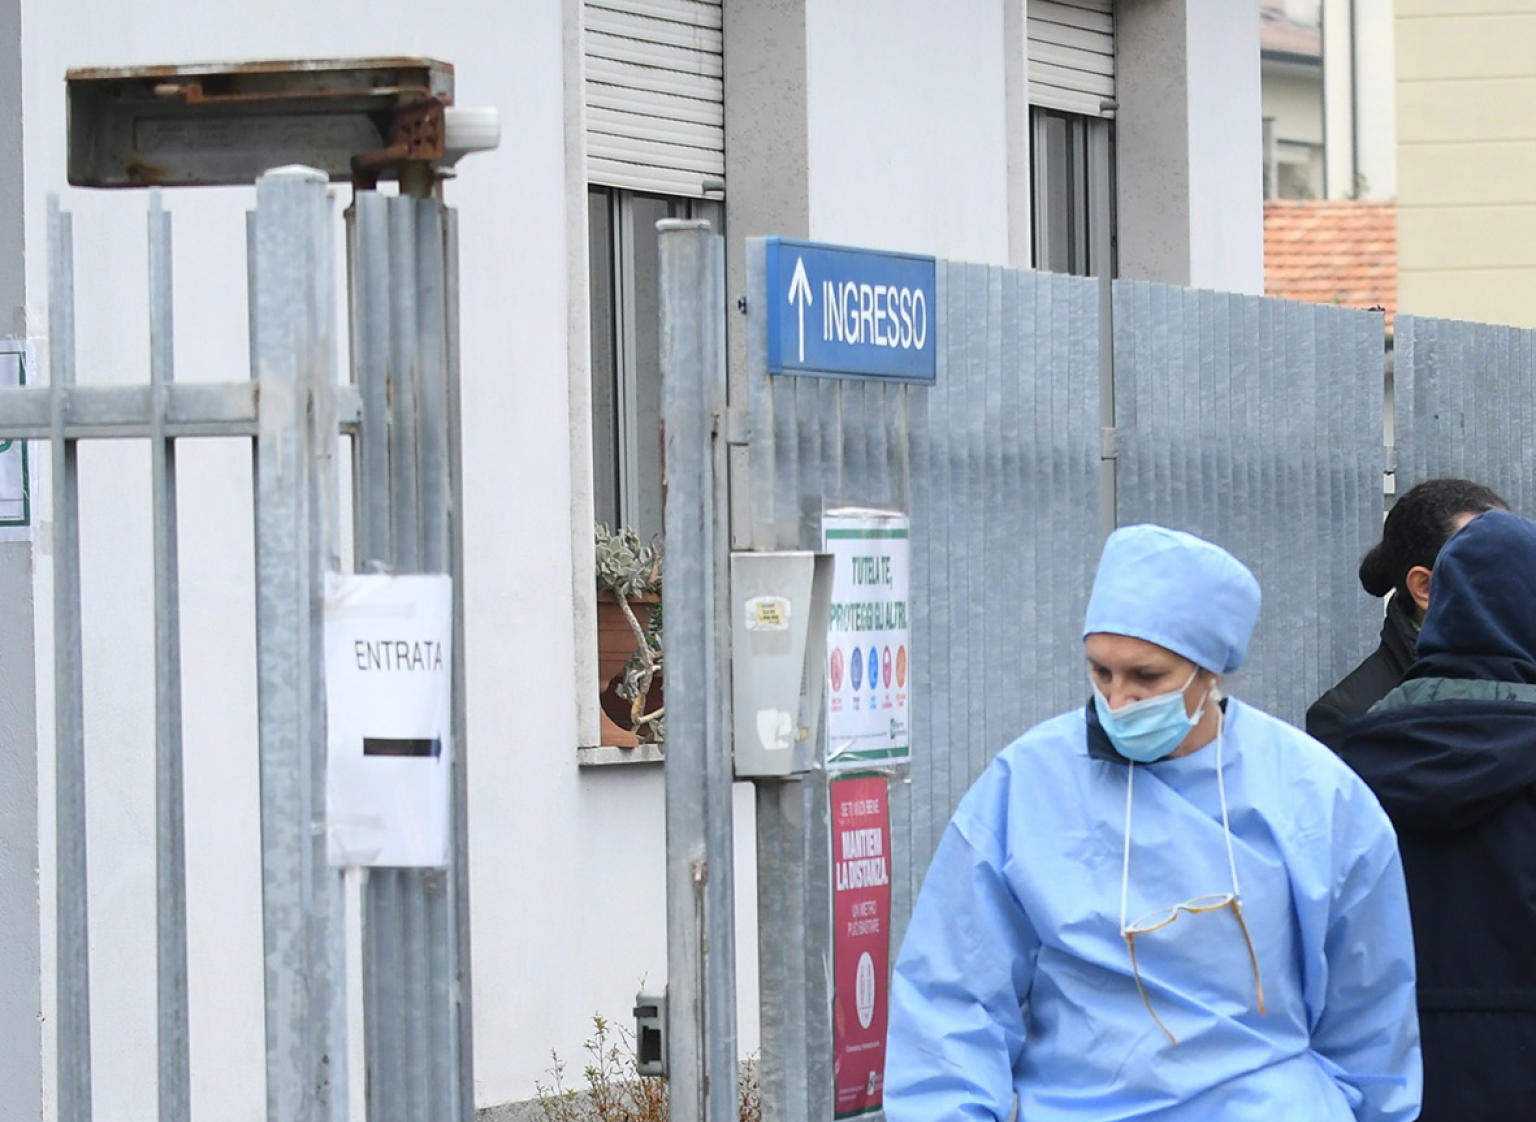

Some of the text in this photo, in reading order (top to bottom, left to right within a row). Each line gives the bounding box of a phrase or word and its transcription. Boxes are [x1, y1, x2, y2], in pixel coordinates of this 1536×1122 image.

[823, 281, 926, 350] INGRESSO
[852, 556, 880, 585] TUTELA
[830, 602, 873, 631] PROTEGGI
[354, 640, 444, 671] ENTRATA
[842, 828, 882, 859] MANTIENI
[836, 861, 848, 891] LA
